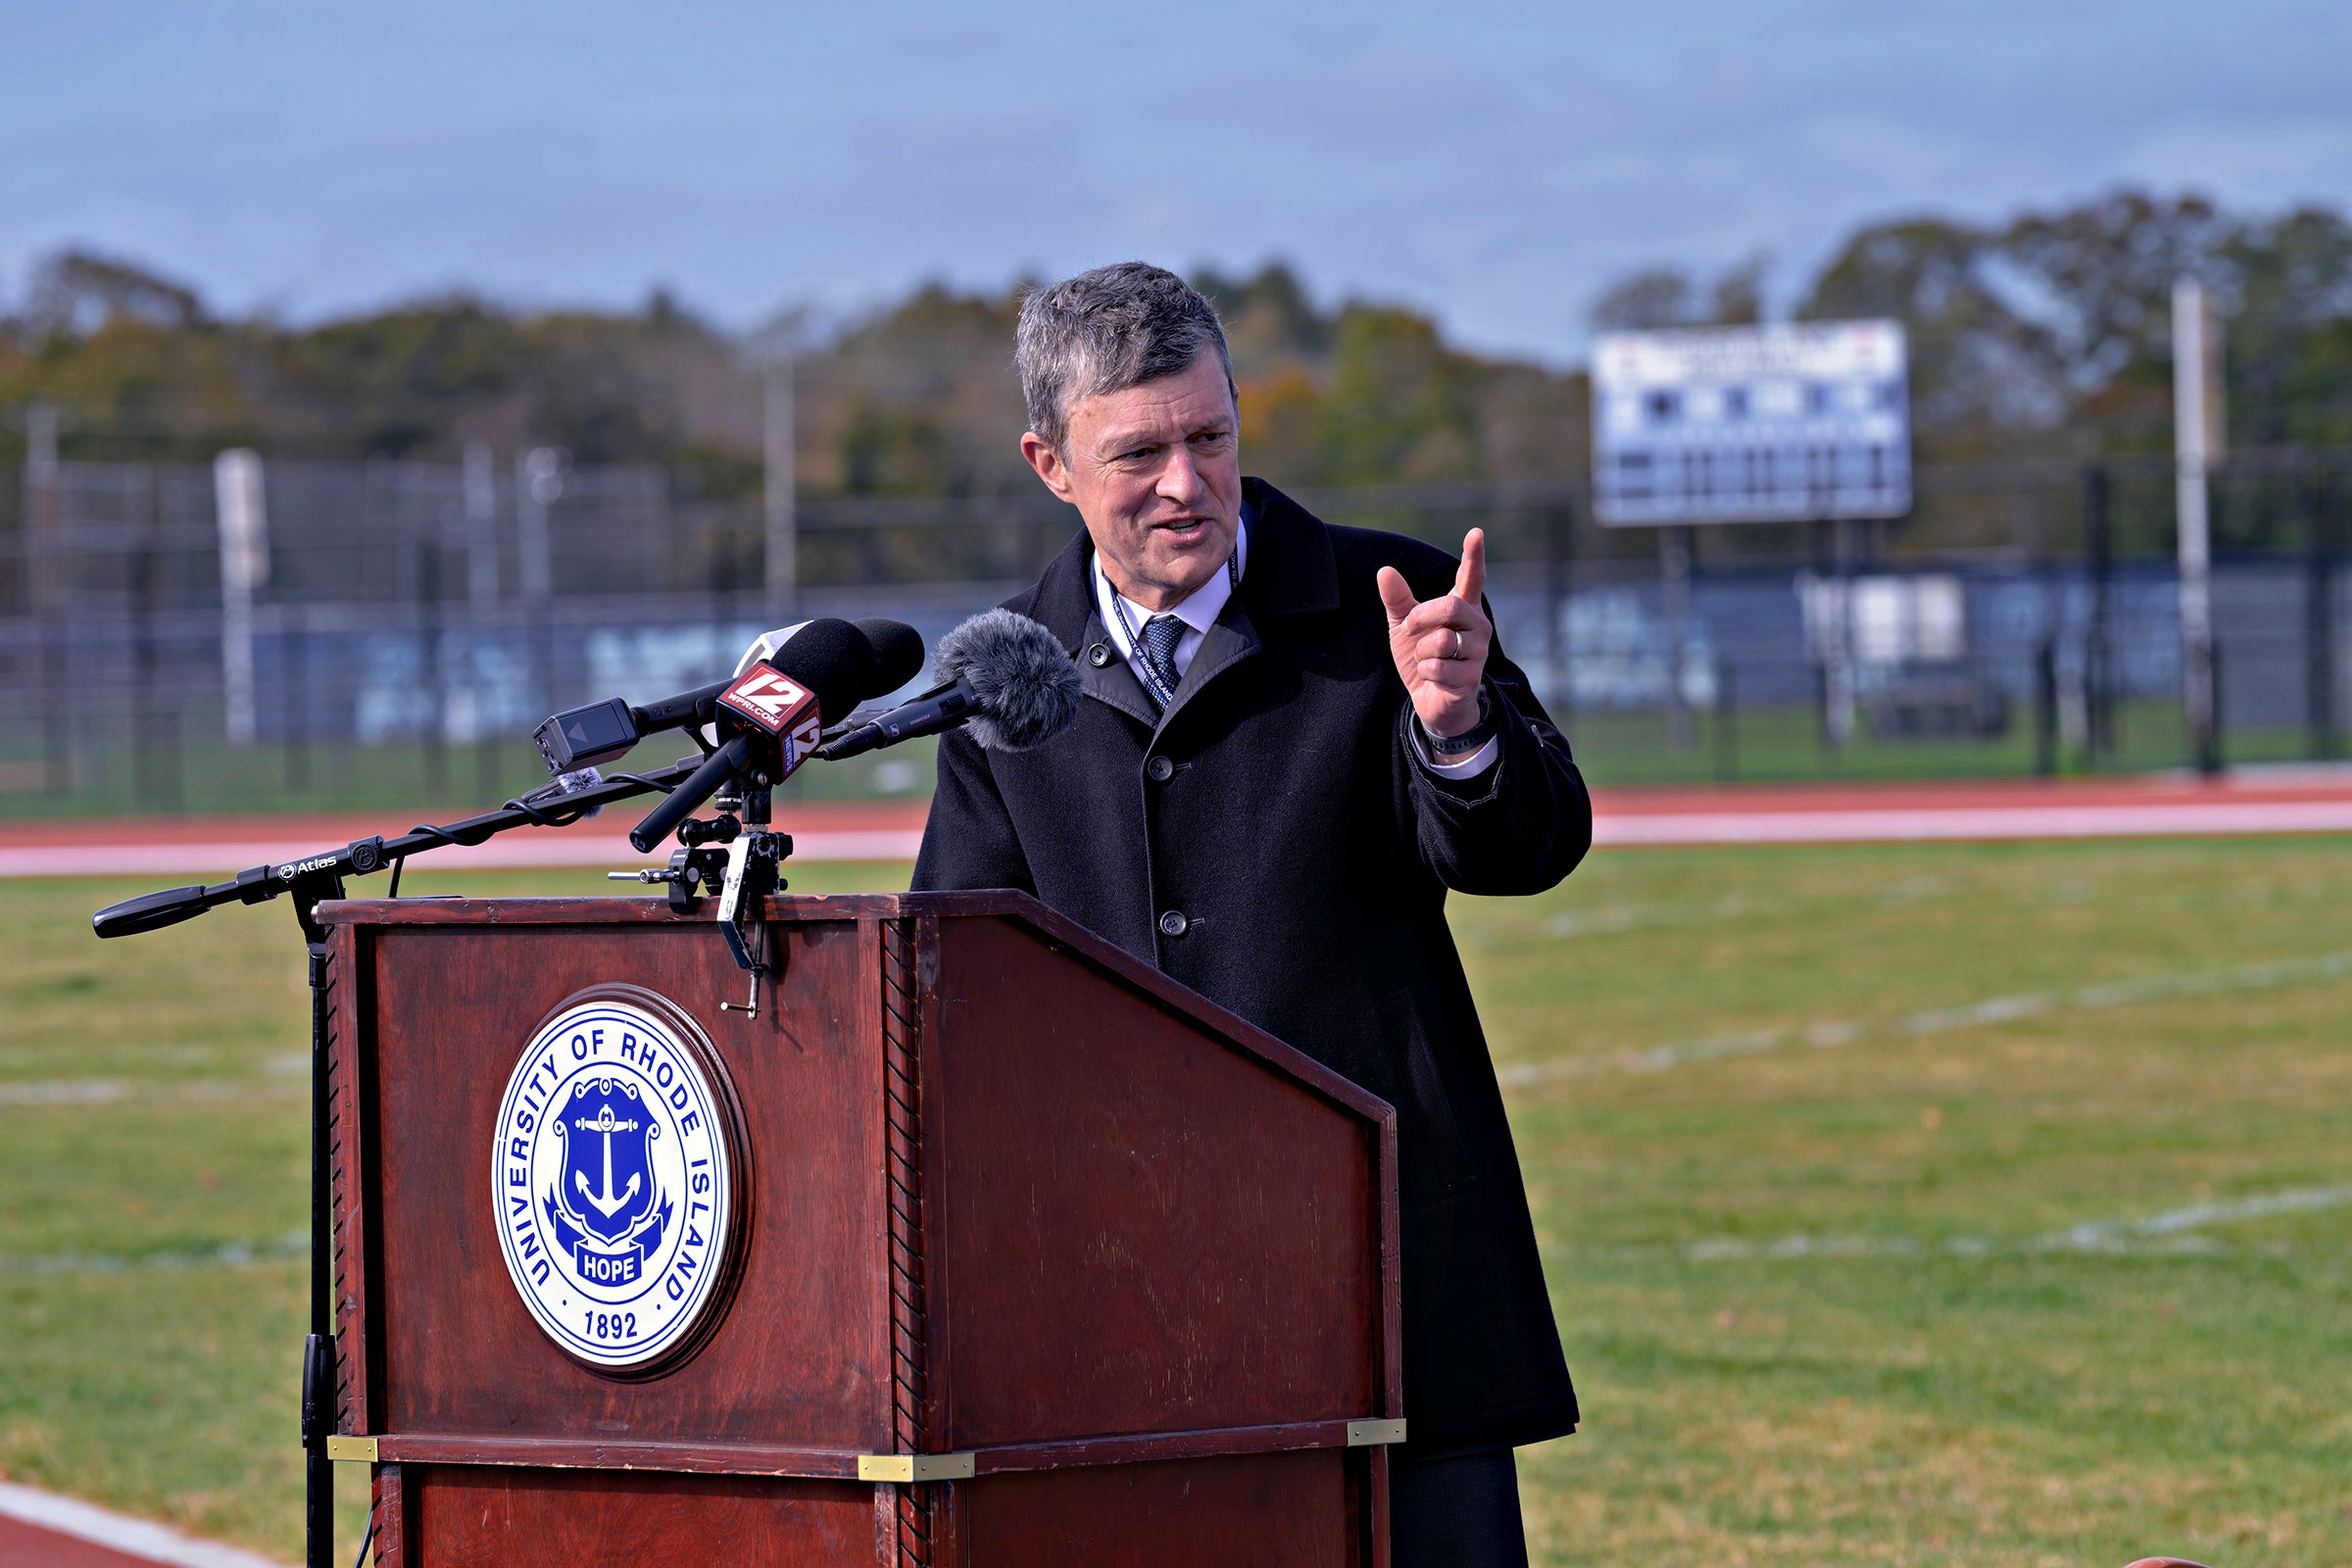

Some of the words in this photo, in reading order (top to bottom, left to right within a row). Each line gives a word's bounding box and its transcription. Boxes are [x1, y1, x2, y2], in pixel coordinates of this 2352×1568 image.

[1135, 648, 1144, 657] OF
[1141, 657, 1157, 679] RHODE
[1155, 678, 1173, 701] ISLAND
[728, 692, 780, 726] WPRI.COM
[735, 673, 806, 716] 12
[791, 716, 820, 762] 12
[297, 856, 337, 874] Atlas
[510, 1054, 560, 1287] UNIVERSITY
[571, 1029, 605, 1060] OF
[620, 1032, 701, 1138] RHODE
[666, 1159, 710, 1301] ISLAND
[584, 1254, 635, 1281] HOPE
[585, 1310, 638, 1340] 1892
